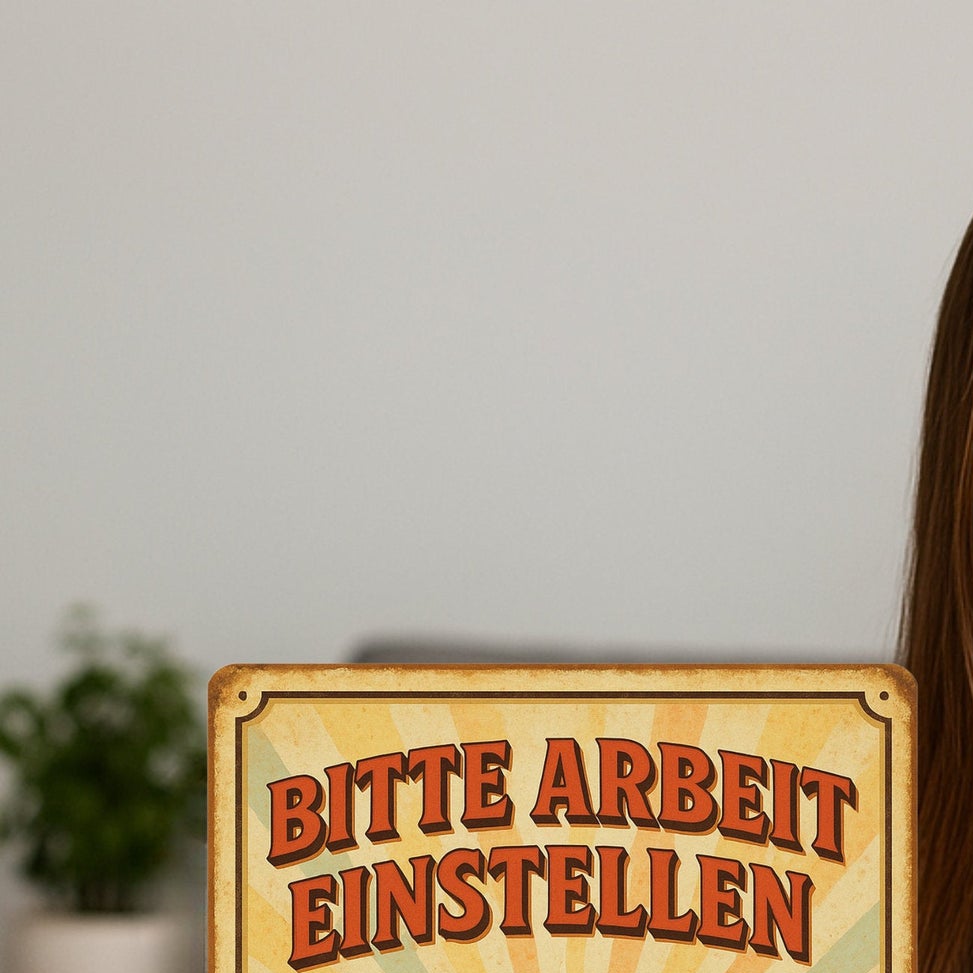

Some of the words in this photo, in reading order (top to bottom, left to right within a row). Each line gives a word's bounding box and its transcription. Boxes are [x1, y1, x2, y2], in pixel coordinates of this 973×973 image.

[267, 740, 513, 867] BITTE
[530, 737, 859, 863] ARBEIT
[287, 845, 815, 971] EINSTELLEN
